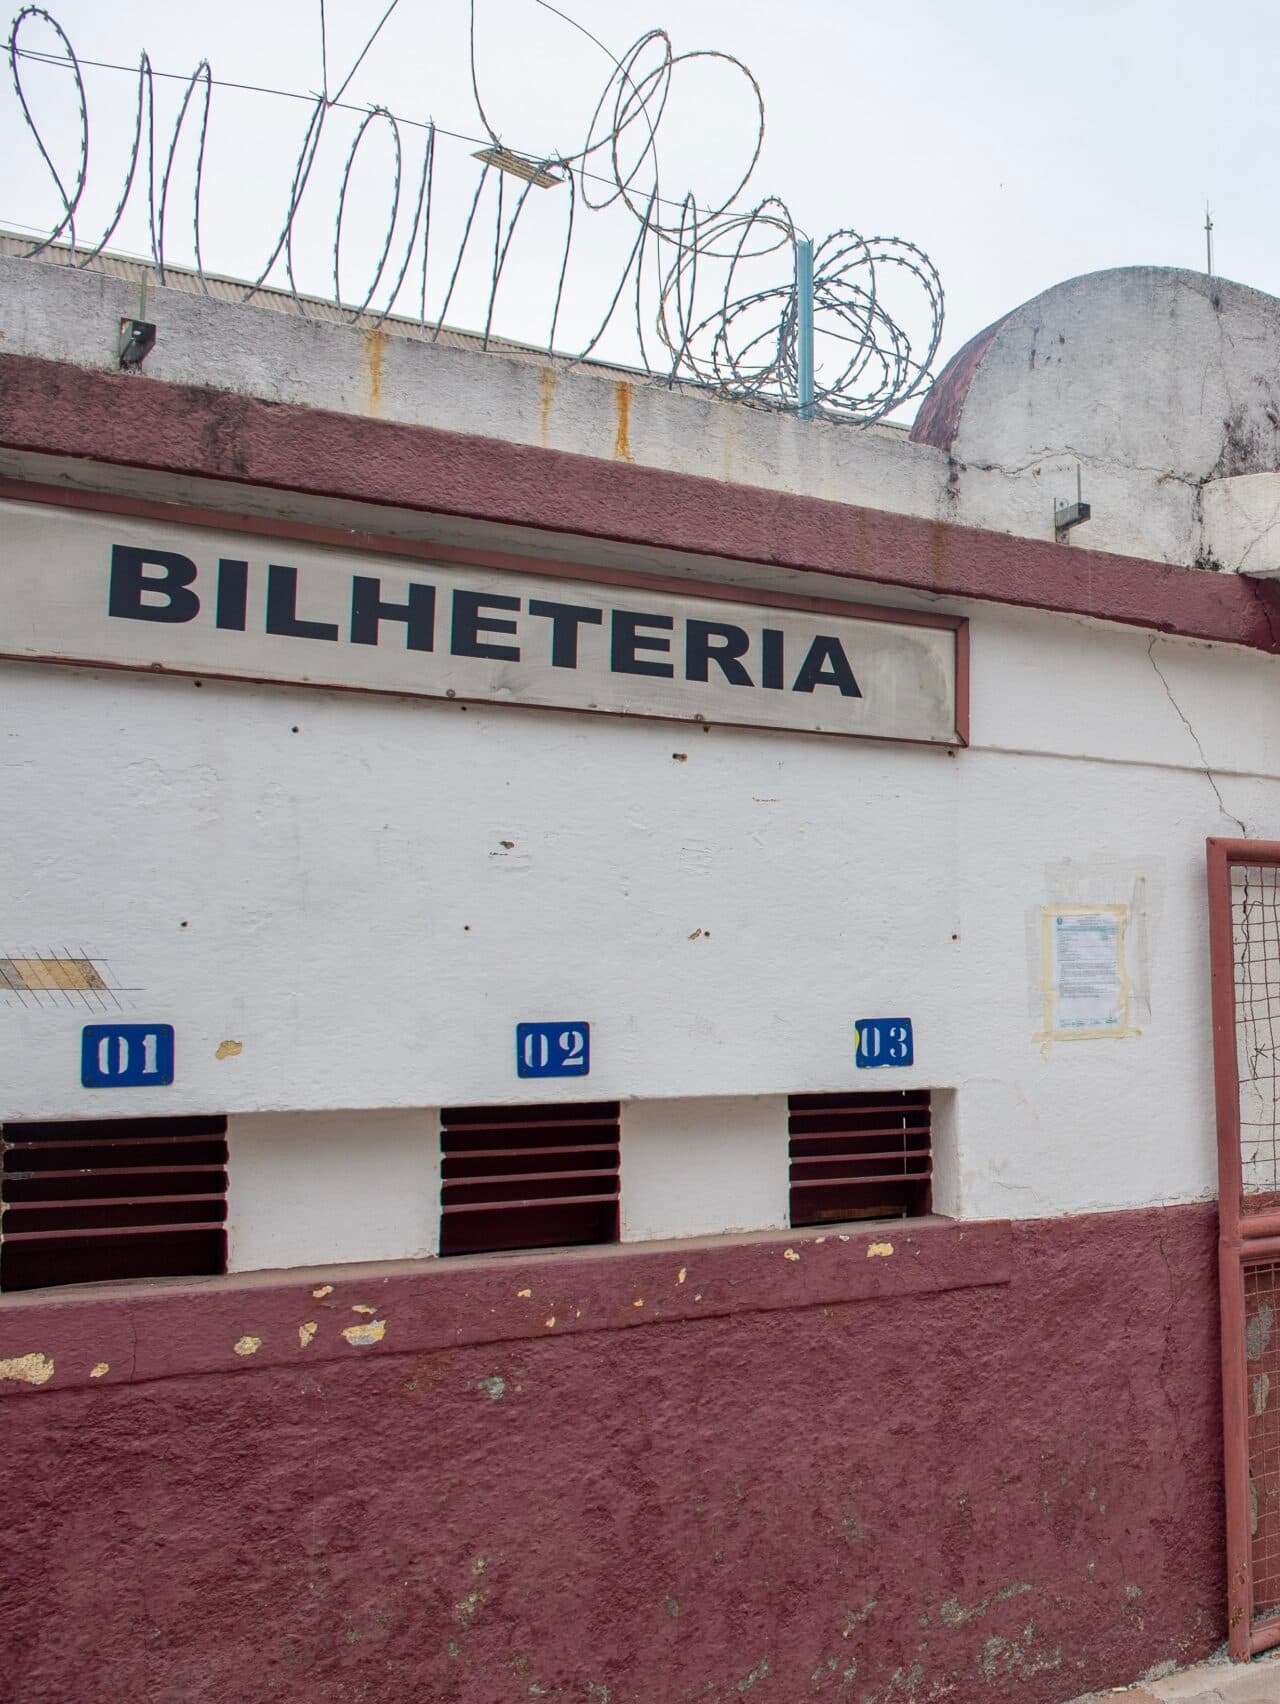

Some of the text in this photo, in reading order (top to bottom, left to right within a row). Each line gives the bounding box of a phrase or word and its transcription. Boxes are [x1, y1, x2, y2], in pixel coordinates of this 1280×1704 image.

[108, 543, 863, 699] BILHETERIA
[97, 1034, 158, 1075] 01
[524, 1031, 584, 1068] 02
[861, 1027, 908, 1058] 03
